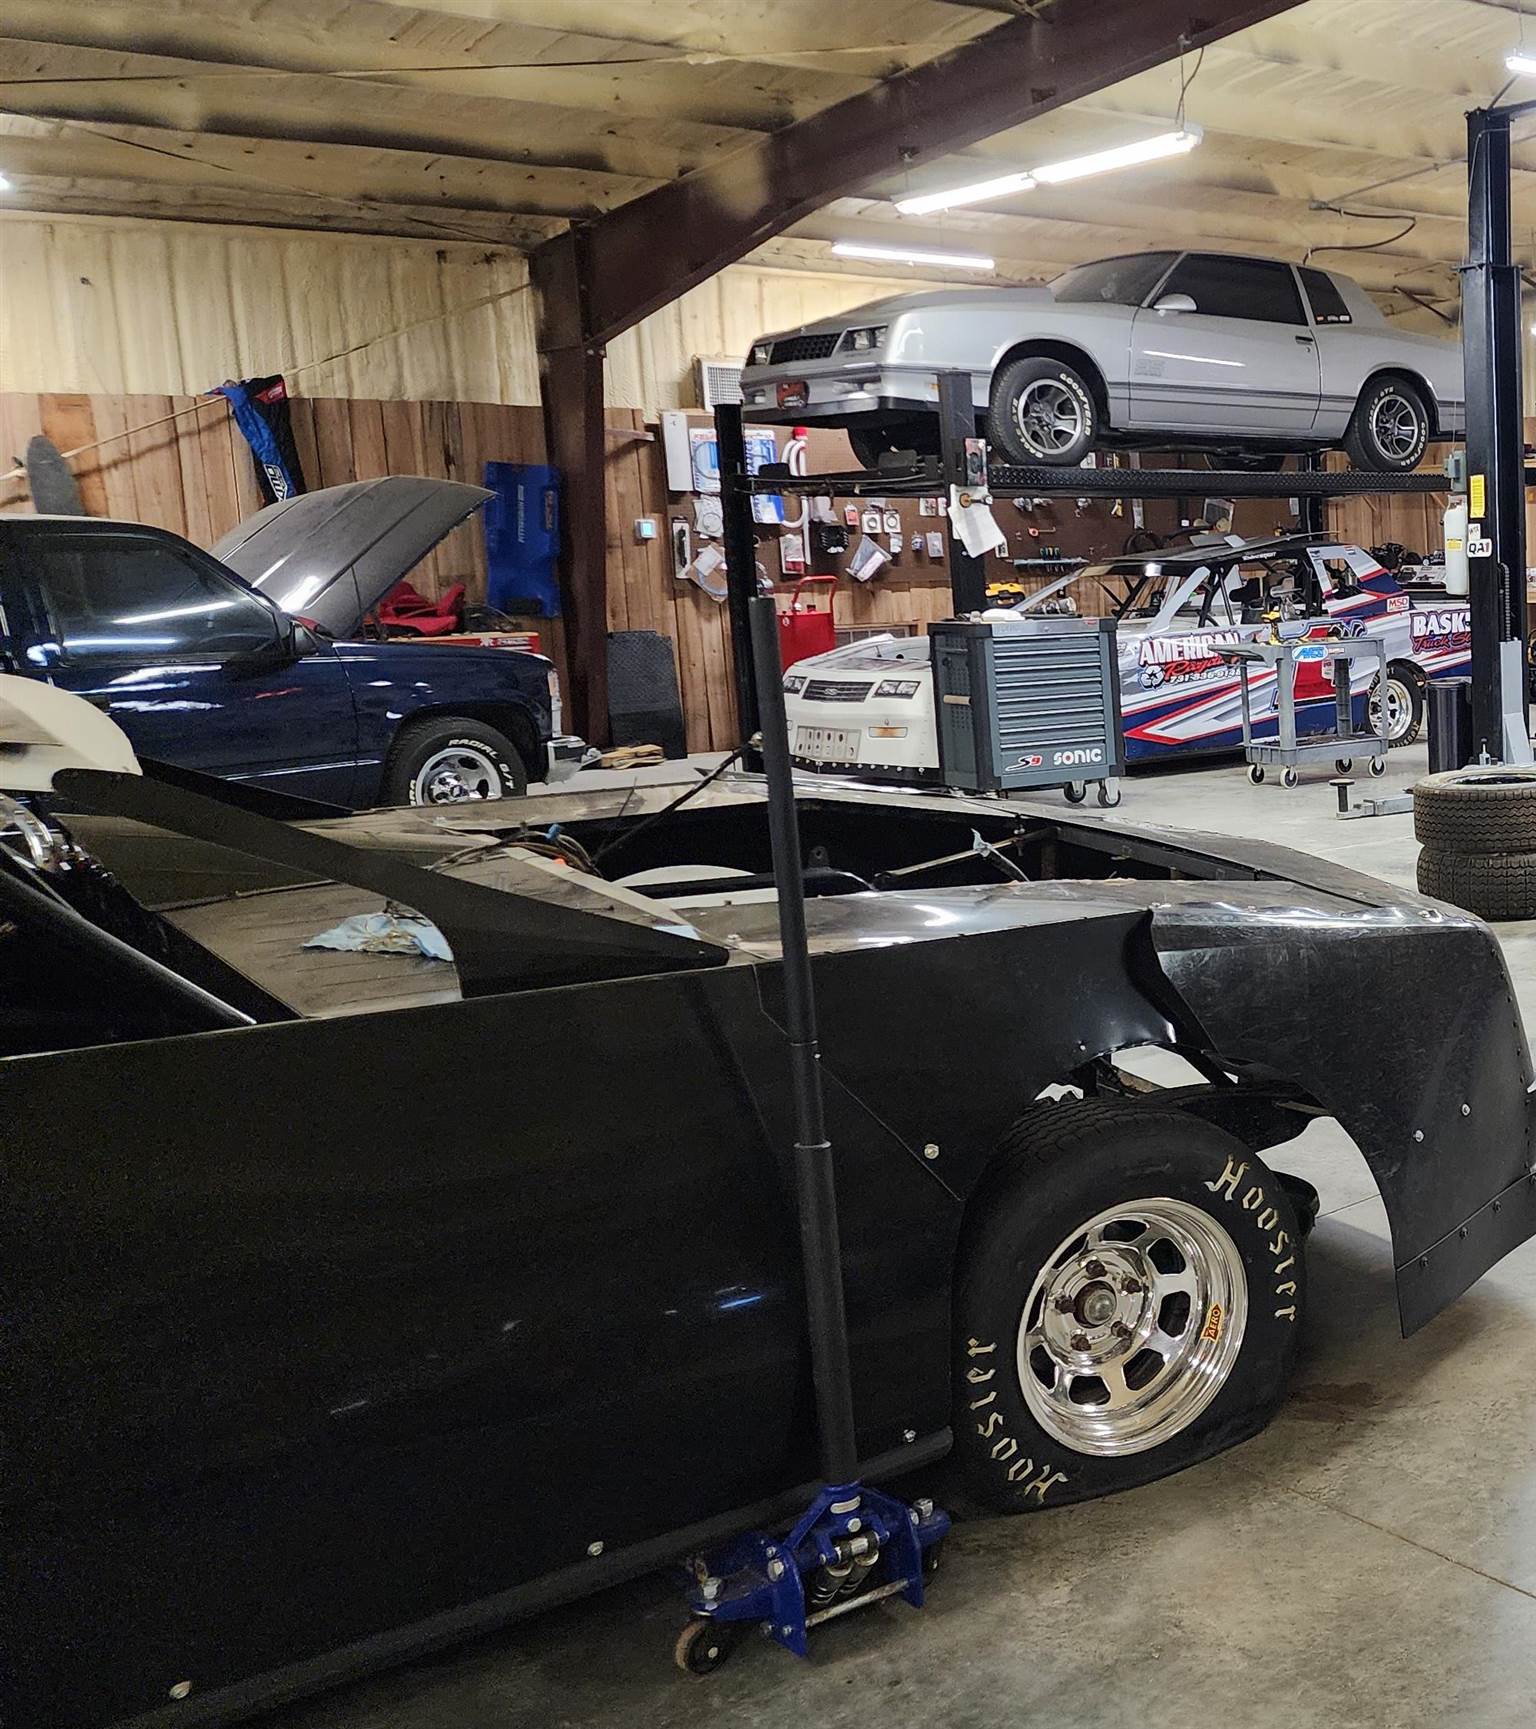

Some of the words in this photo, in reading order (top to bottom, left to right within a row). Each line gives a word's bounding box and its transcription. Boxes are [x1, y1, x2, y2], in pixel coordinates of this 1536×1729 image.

[1060, 373, 1092, 437] GOODYEAR
[1400, 421, 1426, 467] GOODYEAR
[1469, 542, 1490, 554] QA1
[1389, 598, 1408, 608] MSD
[448, 739, 499, 760] RADIAL
[1203, 1154, 1297, 1322] Hoosier
[1209, 1308, 1221, 1337] AERO
[966, 1337, 1069, 1504] Hoosier
